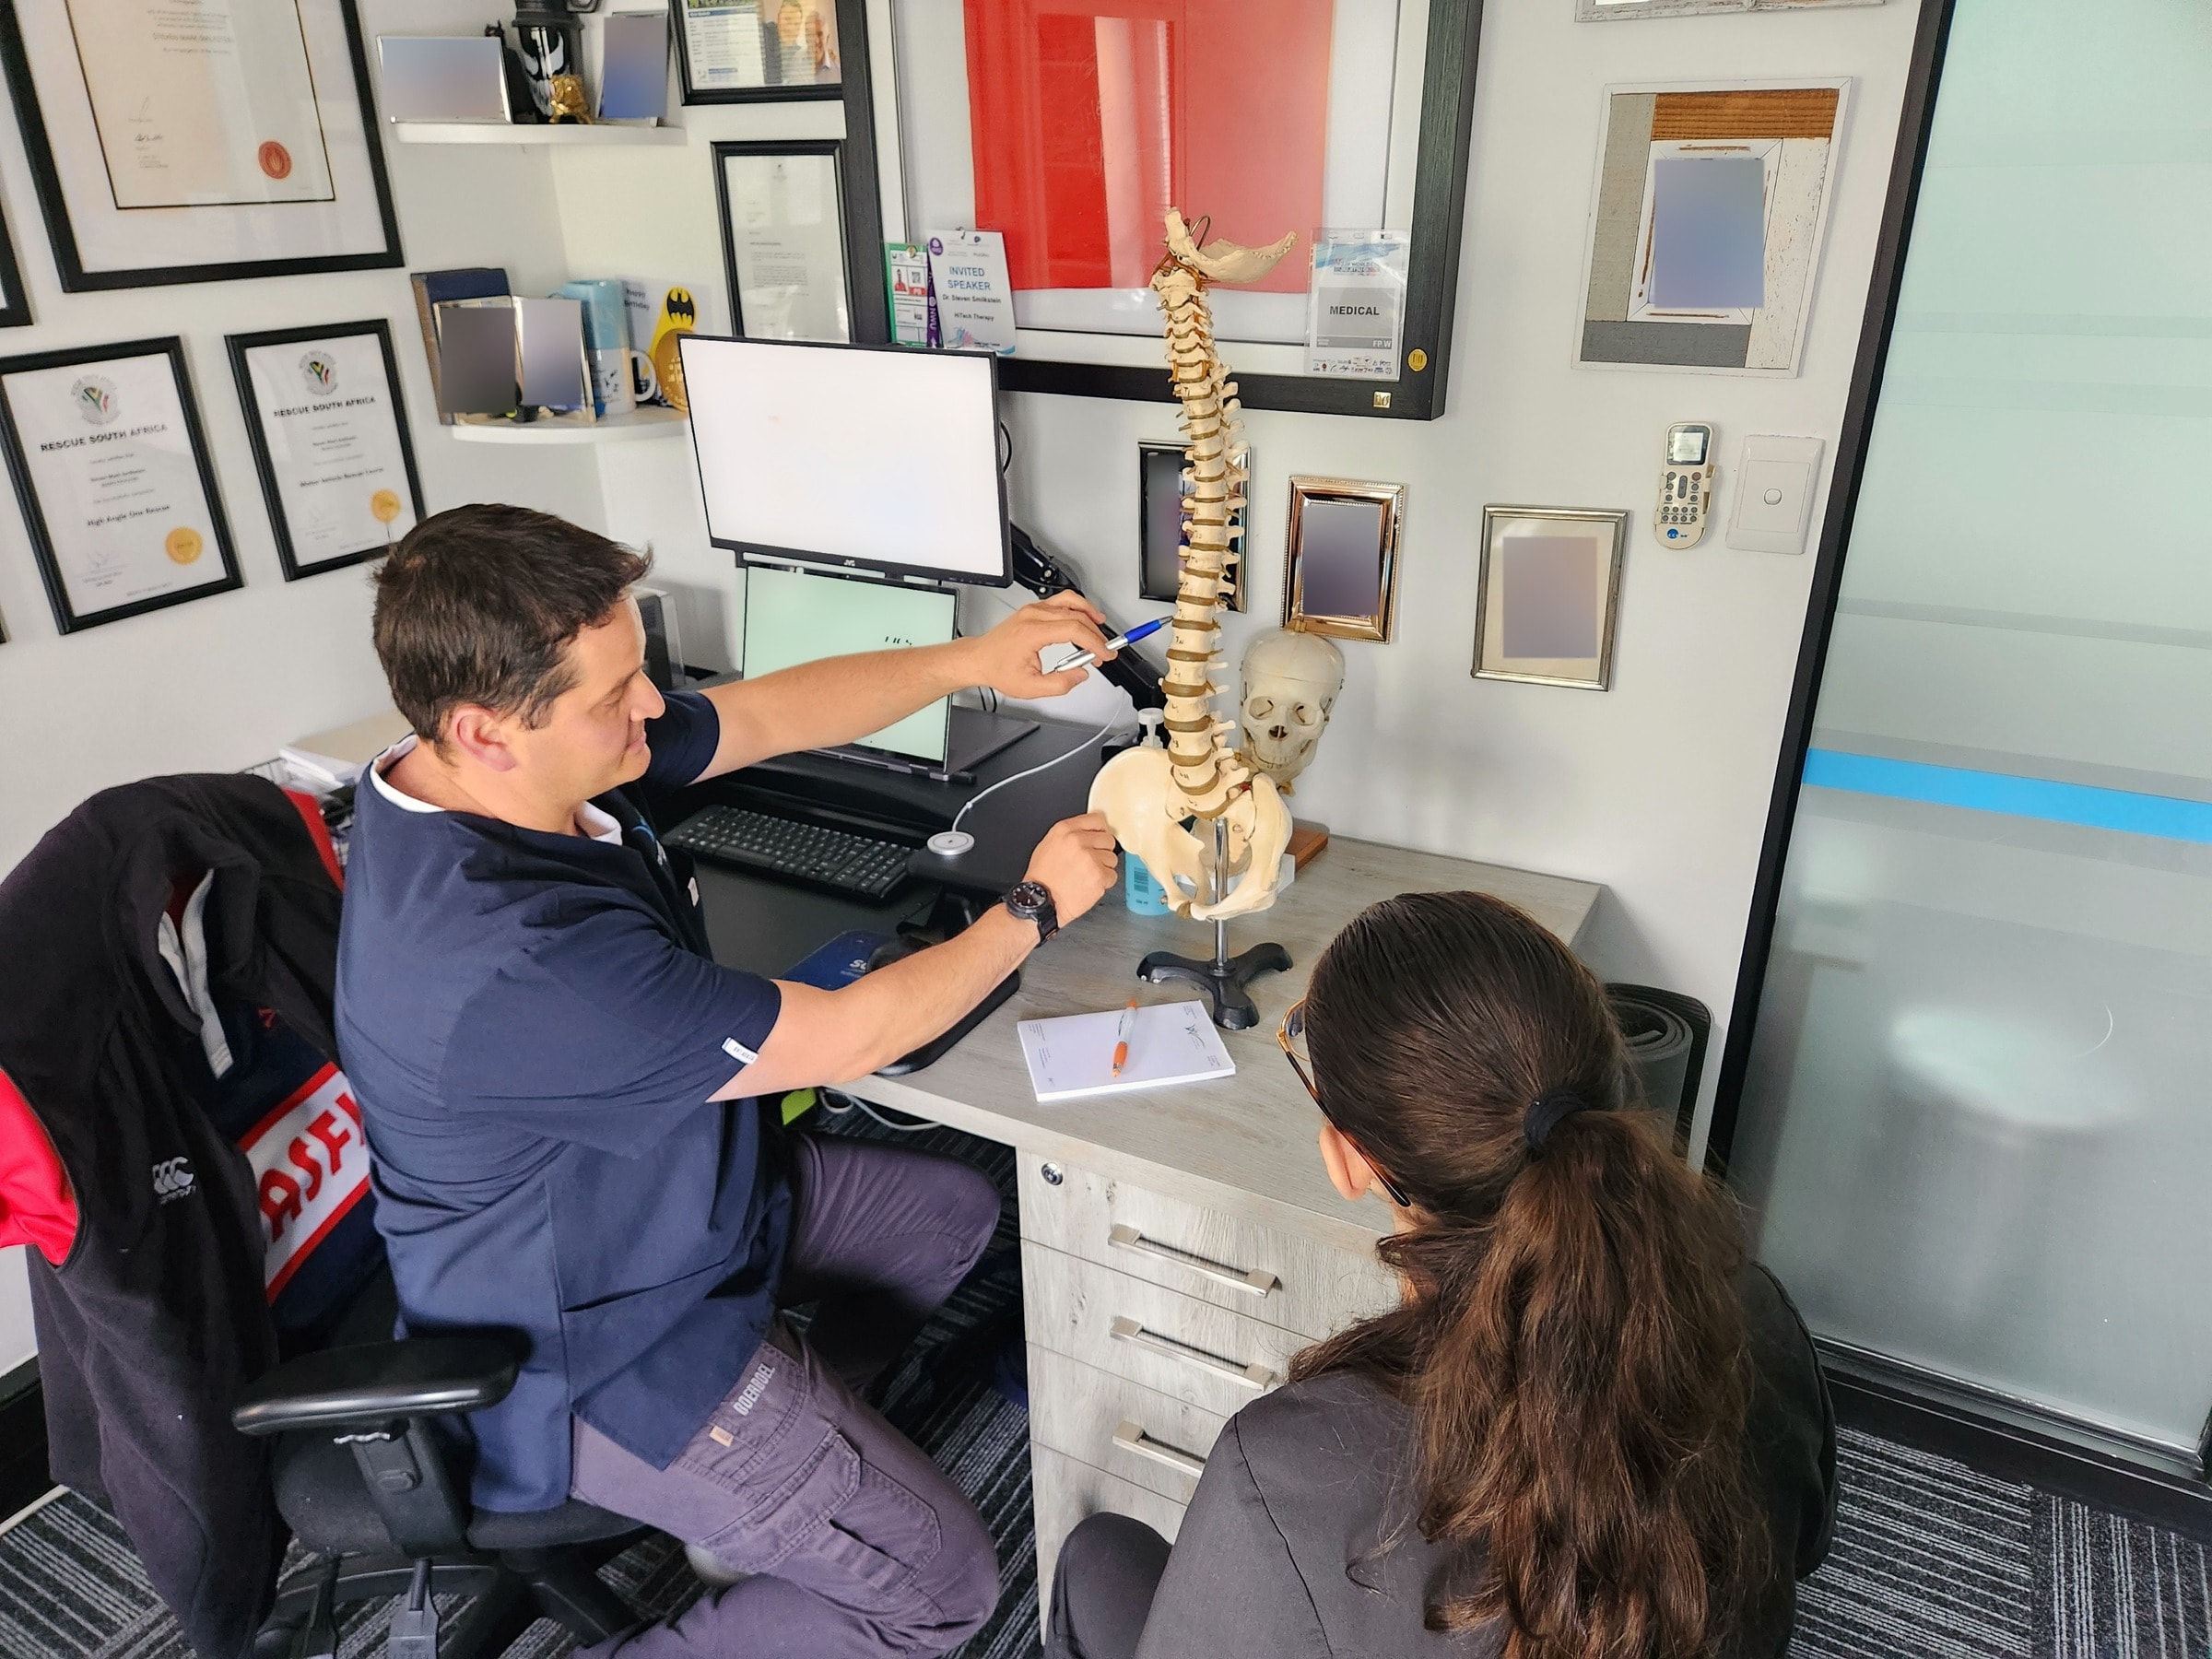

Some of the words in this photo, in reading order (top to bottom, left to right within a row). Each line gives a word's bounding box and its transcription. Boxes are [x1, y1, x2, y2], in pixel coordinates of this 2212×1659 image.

[949, 266, 985, 276] INVITED
[947, 279, 991, 291] SPEAKER
[1329, 305, 1380, 316] MEDICAL
[274, 406, 310, 418] RESCUE
[312, 401, 343, 412] SOUTH
[346, 396, 376, 407] AFRICA
[40, 436, 87, 452] RESCUE
[88, 429, 127, 443] SOUTH
[130, 424, 168, 437] AFRICA
[843, 559, 855, 567] JVC
[733, 1362, 776, 1417] BOERBOEL
